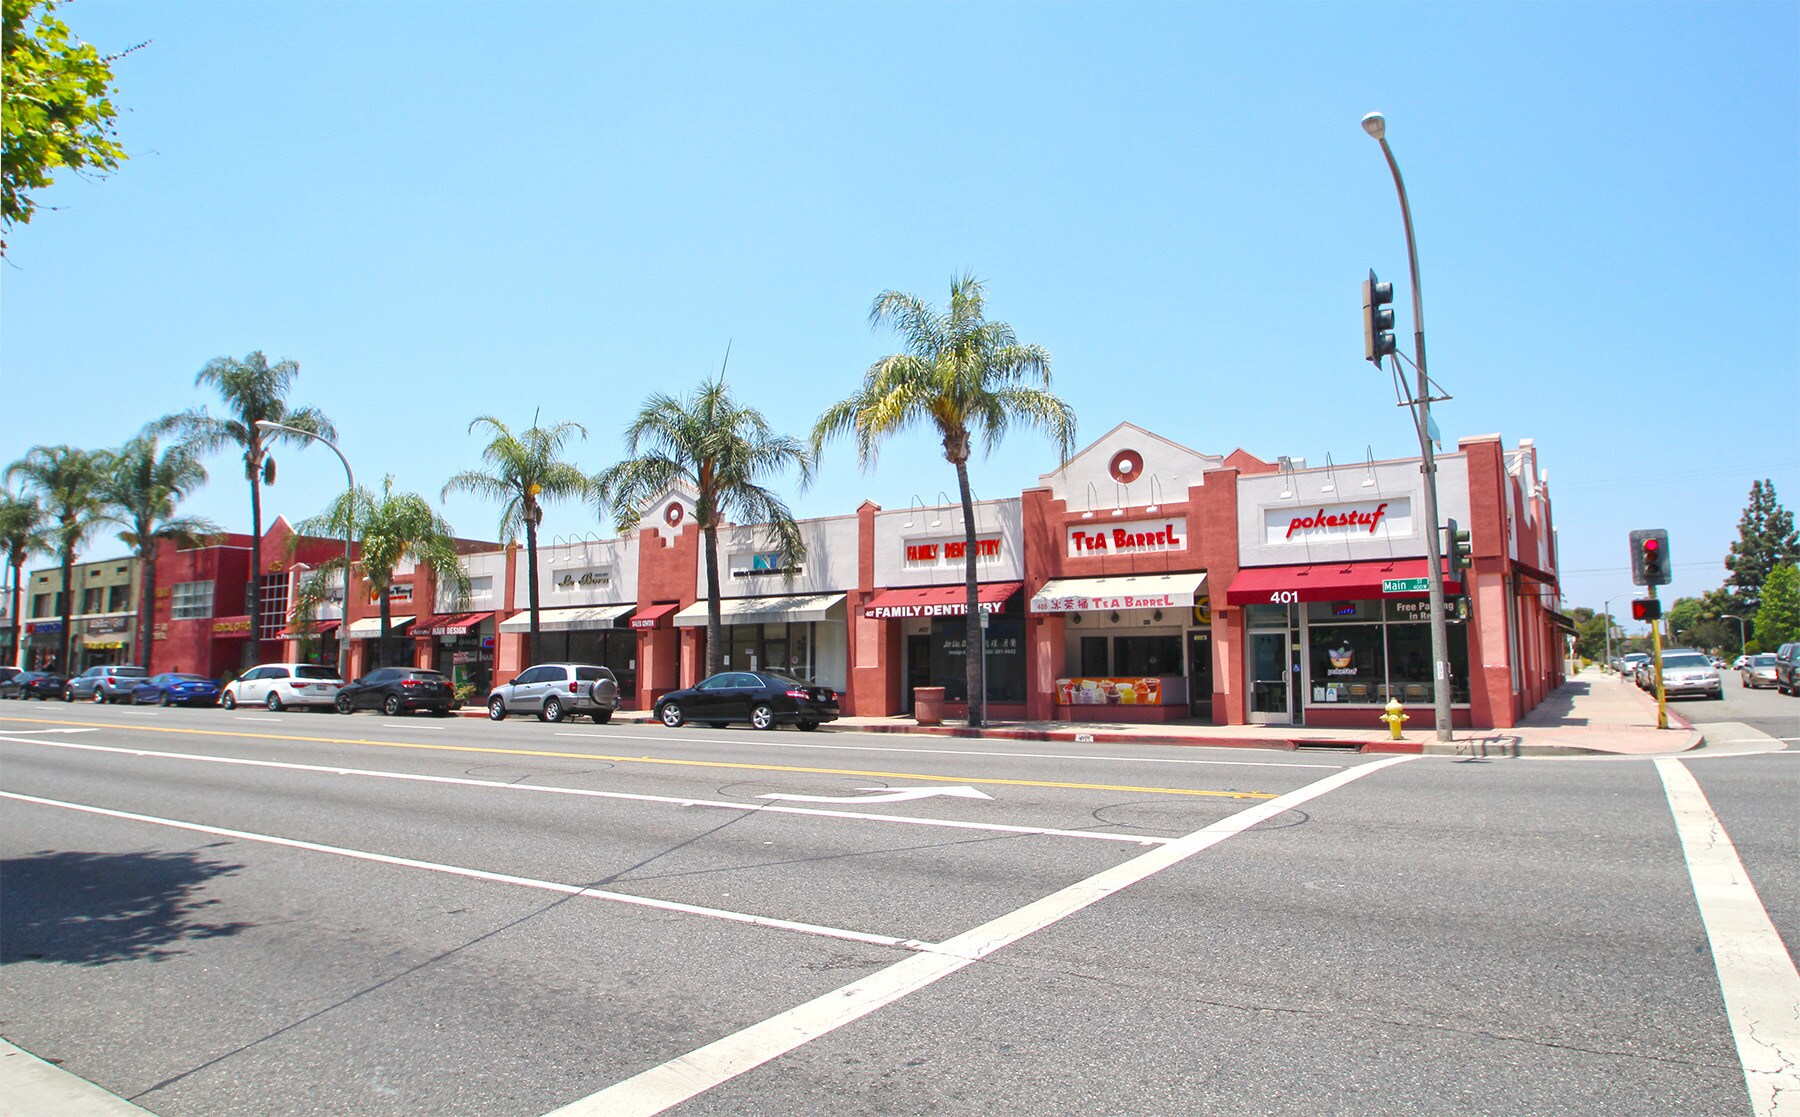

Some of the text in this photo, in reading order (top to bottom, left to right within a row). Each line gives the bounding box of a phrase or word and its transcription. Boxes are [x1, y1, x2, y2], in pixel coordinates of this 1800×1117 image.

[1286, 503, 1388, 538] pokestuf
[907, 544, 938, 561] FAMILY
[1384, 582, 1406, 591] Main
[1270, 591, 1298, 604] 401
[875, 606, 921, 618] FAMILY
[1397, 601, 1454, 612] Free Pang
[432, 627, 446, 635] HAIR
[446, 626, 467, 635] DESIGN
